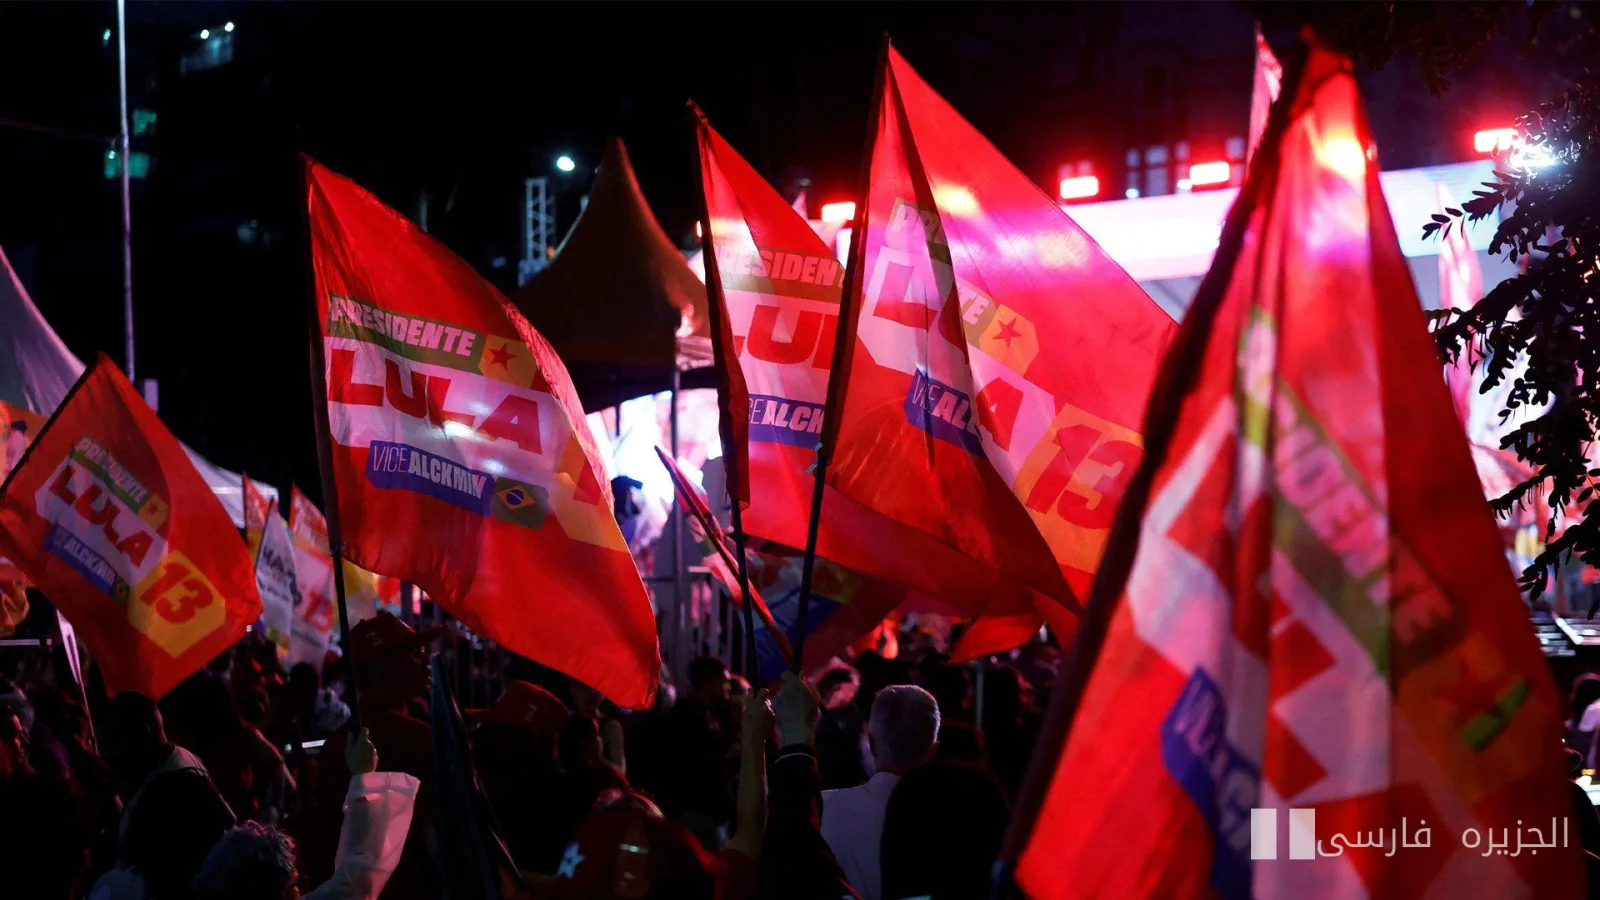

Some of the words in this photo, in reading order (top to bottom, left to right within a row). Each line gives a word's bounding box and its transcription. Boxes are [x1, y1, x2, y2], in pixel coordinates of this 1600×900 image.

[330, 296, 477, 358] PRESIDENTE
[328, 348, 543, 455] LULA
[371, 444, 409, 473] VICE
[408, 451, 487, 499] ALCKMIN
[1025, 424, 1145, 530] 13
[49, 464, 154, 568] LULA
[139, 562, 214, 624] 13
